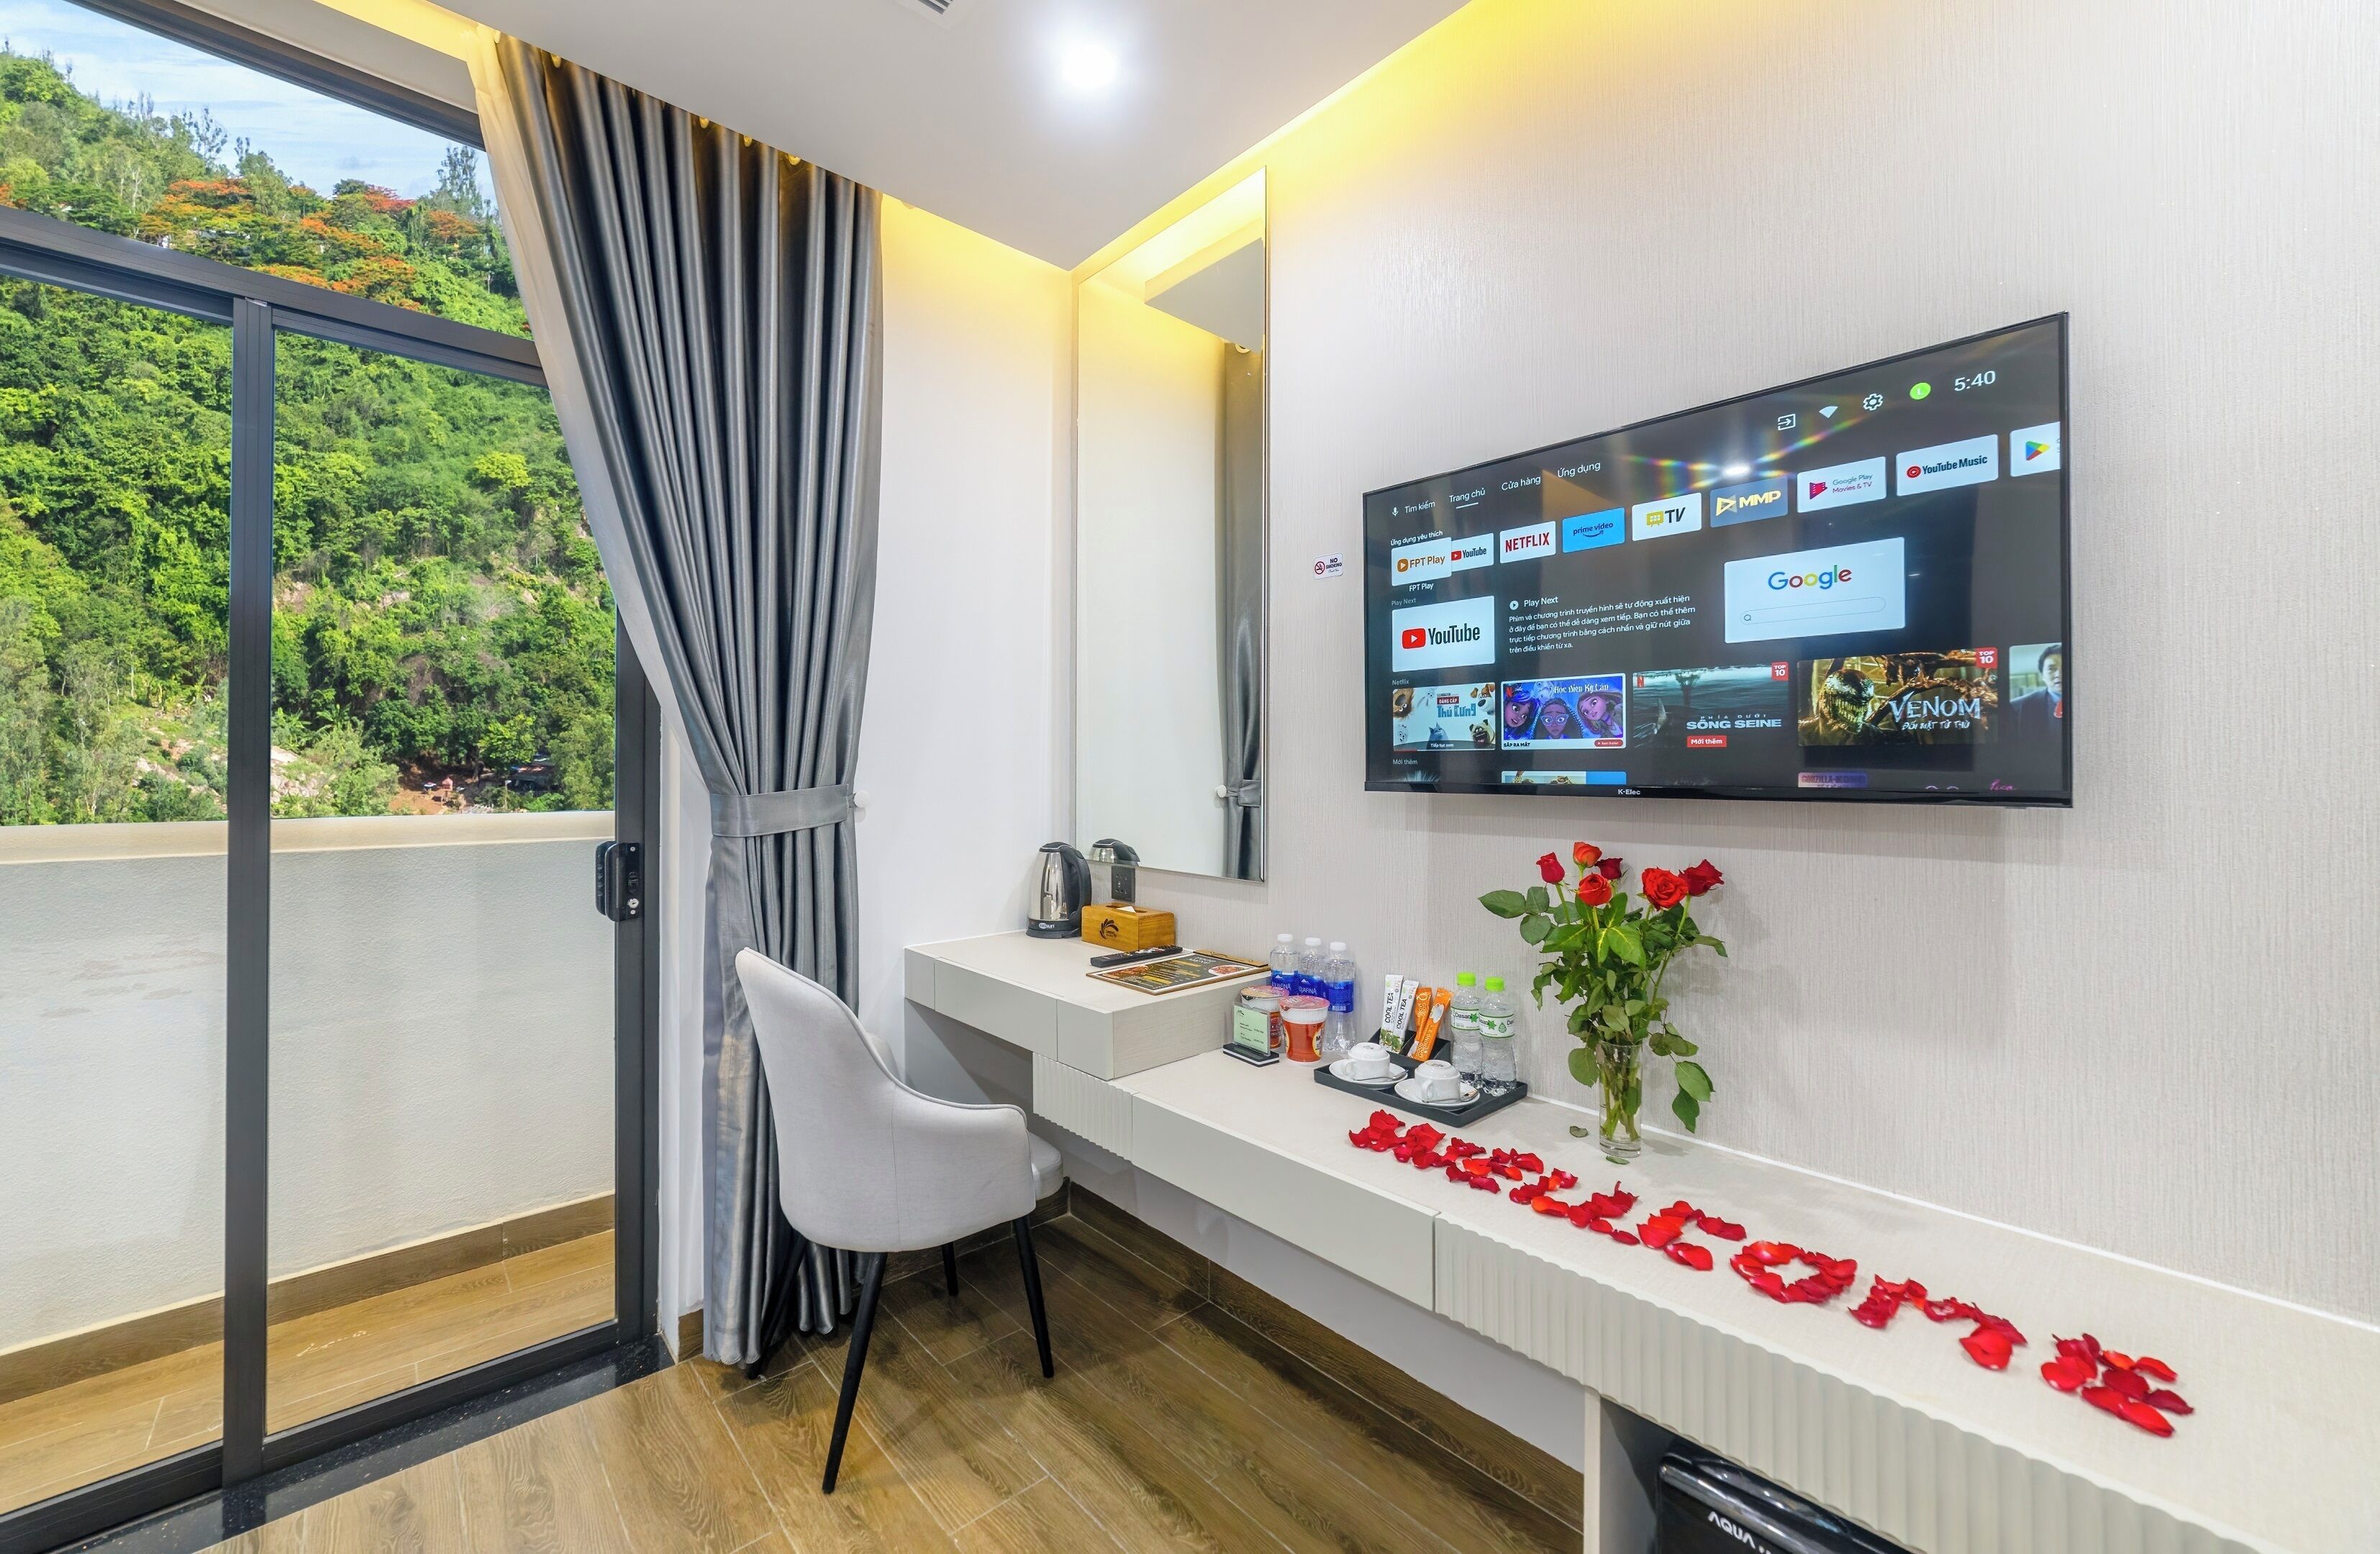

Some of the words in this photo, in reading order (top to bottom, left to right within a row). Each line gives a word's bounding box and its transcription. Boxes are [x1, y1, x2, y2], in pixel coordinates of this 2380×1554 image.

[1954, 371, 1996, 391] 5:40
[1557, 467, 1576, 479] Ứng
[1577, 461, 1601, 474] dụng
[1922, 461, 1958, 474] YouTube
[1958, 455, 1988, 468] Music
[1502, 481, 1519, 491] Cửa
[1520, 476, 1541, 486] hàng
[1832, 476, 1857, 486] Google
[1858, 473, 1873, 483] Play
[1449, 492, 1470, 504] Trang
[1471, 486, 1486, 498] chủ
[1832, 484, 1856, 494] Movies
[1740, 490, 1781, 509] MMP
[1573, 524, 1593, 536] prime
[1594, 521, 1614, 531] video
[1390, 537, 1402, 546] Ứng
[1402, 536, 1416, 545] dụng
[1505, 532, 1550, 553] NETFLIX
[1462, 547, 1487, 558] YouTube
[1409, 558, 1425, 568] FPT
[1427, 555, 1445, 565] Play
[1768, 565, 1853, 590] Google
[1533, 611, 1558, 619] chương
[1673, 595, 1690, 604] hiện
[1541, 596, 1559, 605] Next
[1675, 606, 1696, 615] thêm
[1427, 623, 1481, 645] YouTube
[1537, 632, 1562, 640] chương
[1979, 655, 1994, 664] 10
[1889, 691, 1981, 723] VENOM
[1686, 719, 1731, 730] SÔNG
[1734, 719, 1782, 729] SEINE
[1384, 1007, 1393, 1023] COOL
[1415, 1042, 1424, 1057] GOOD
[1707, 1511, 1756, 1550] AQUA
